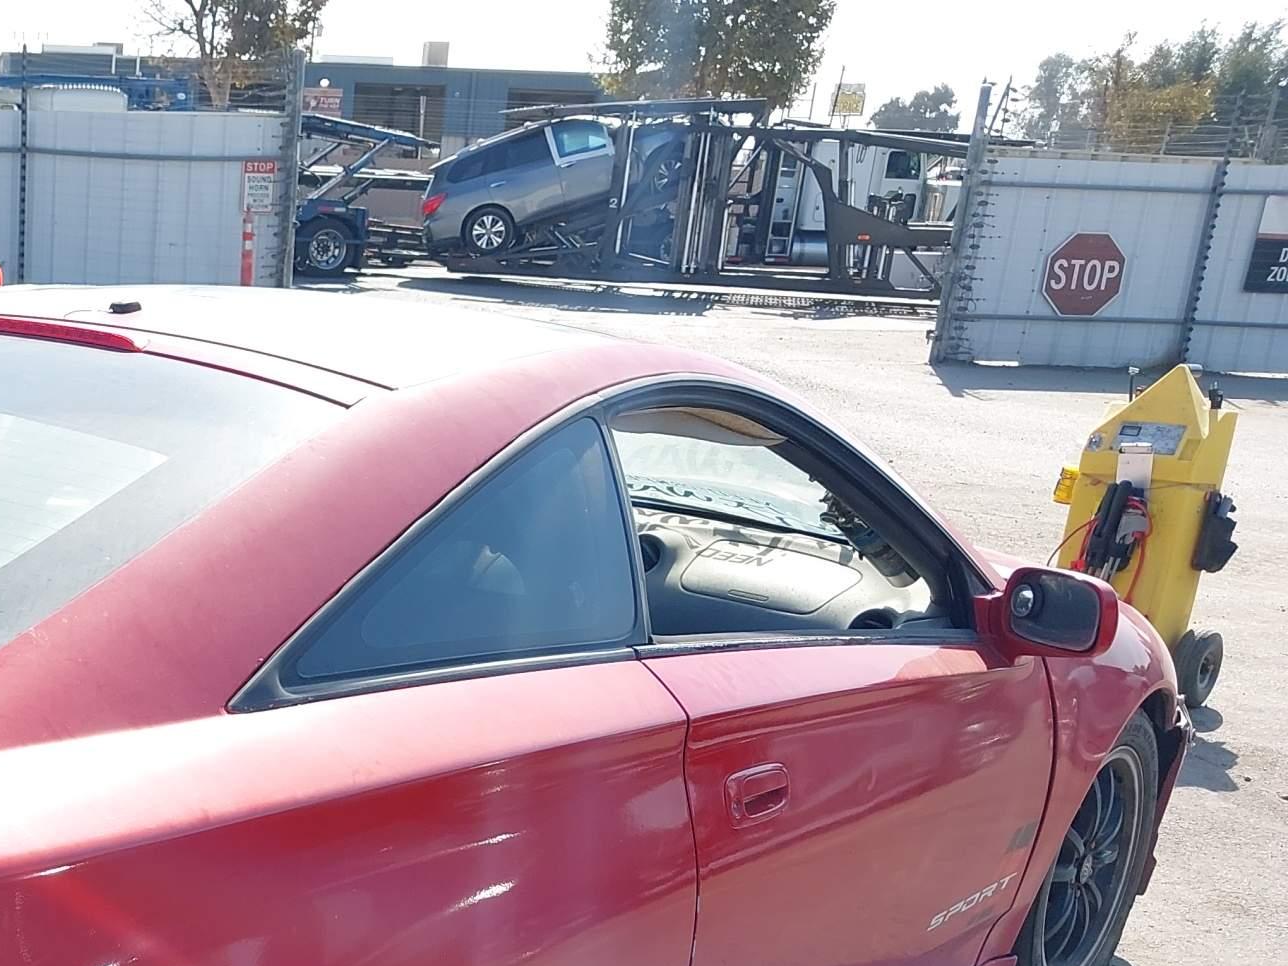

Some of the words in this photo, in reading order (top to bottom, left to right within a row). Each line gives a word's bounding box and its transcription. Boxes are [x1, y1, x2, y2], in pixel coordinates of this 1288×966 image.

[246, 162, 274, 172] STOP
[249, 184, 269, 192] HORN
[1050, 259, 1120, 290] STOP
[1267, 266, 1288, 282] ZO
[928, 872, 1017, 932] SPORT
